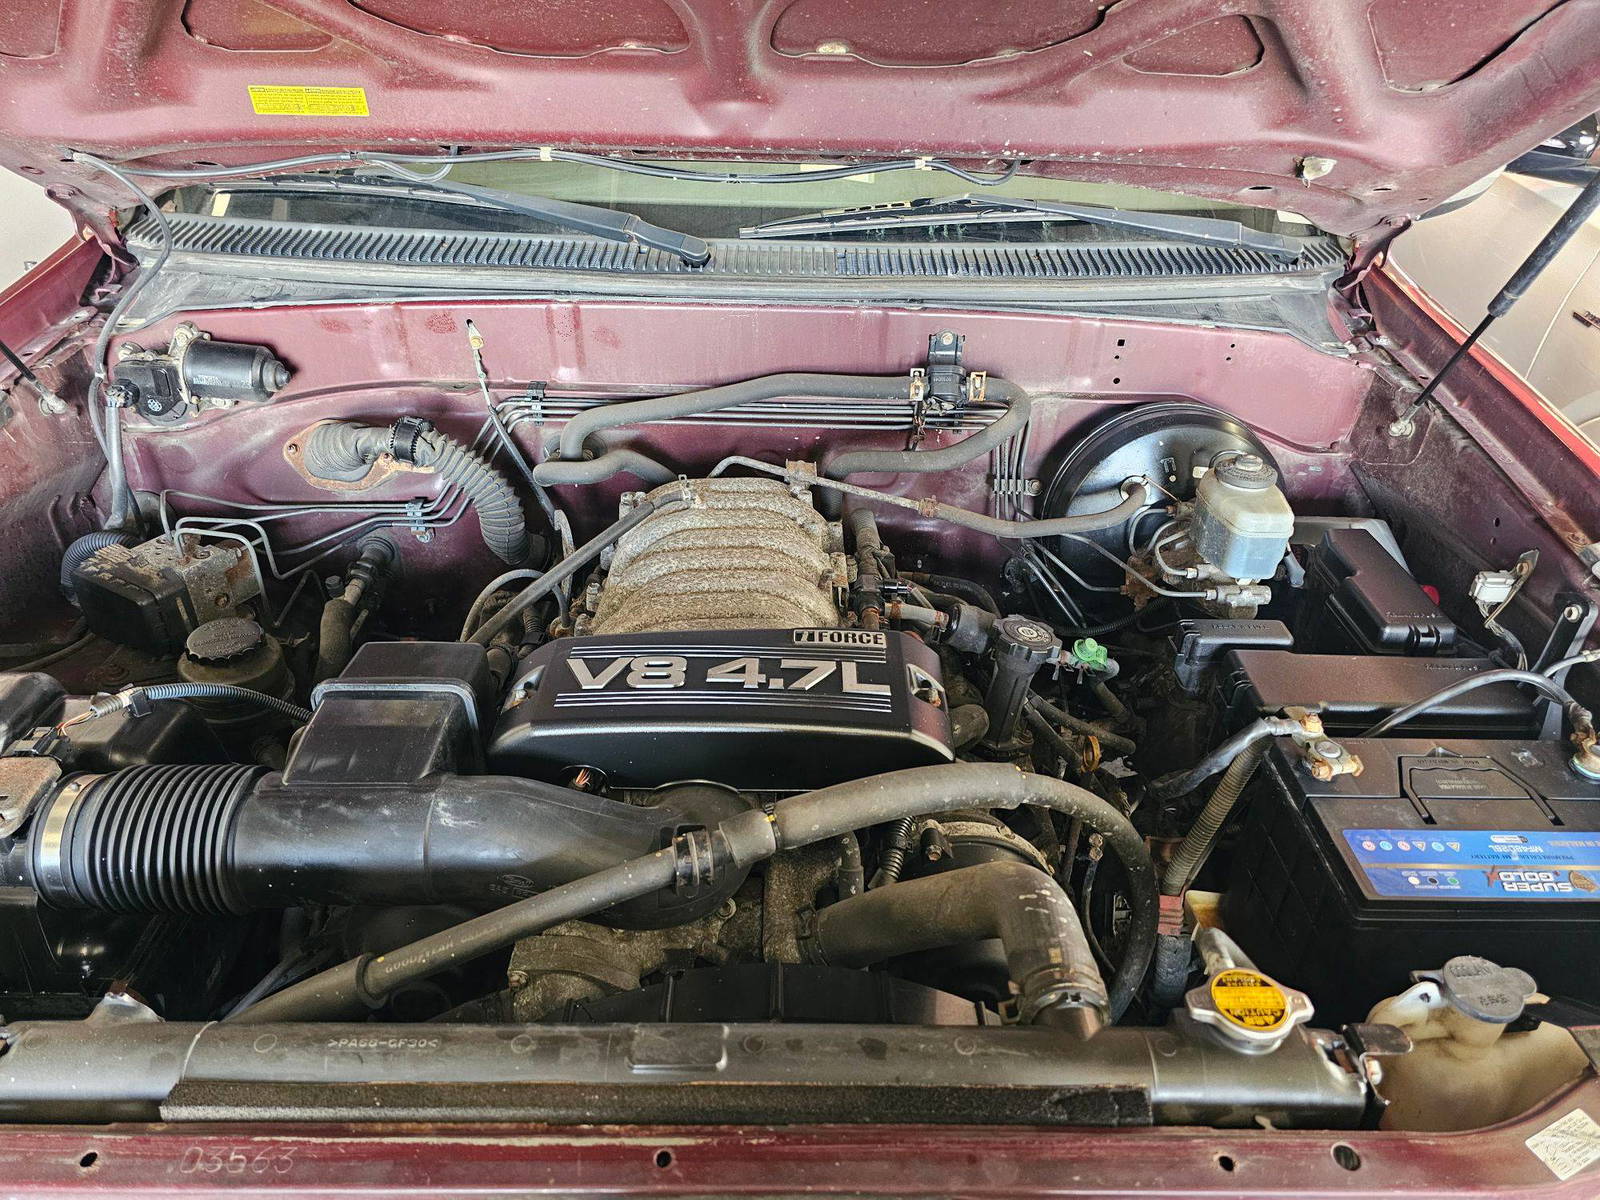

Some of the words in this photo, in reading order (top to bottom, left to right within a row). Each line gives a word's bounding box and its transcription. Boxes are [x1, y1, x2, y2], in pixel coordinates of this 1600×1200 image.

[566, 656, 688, 690] V8
[705, 657, 892, 696] 4.7L
[1499, 871, 1555, 882] GOLD
[1502, 881, 1574, 893] SUPER
[179, 1146, 299, 1175] 03563
